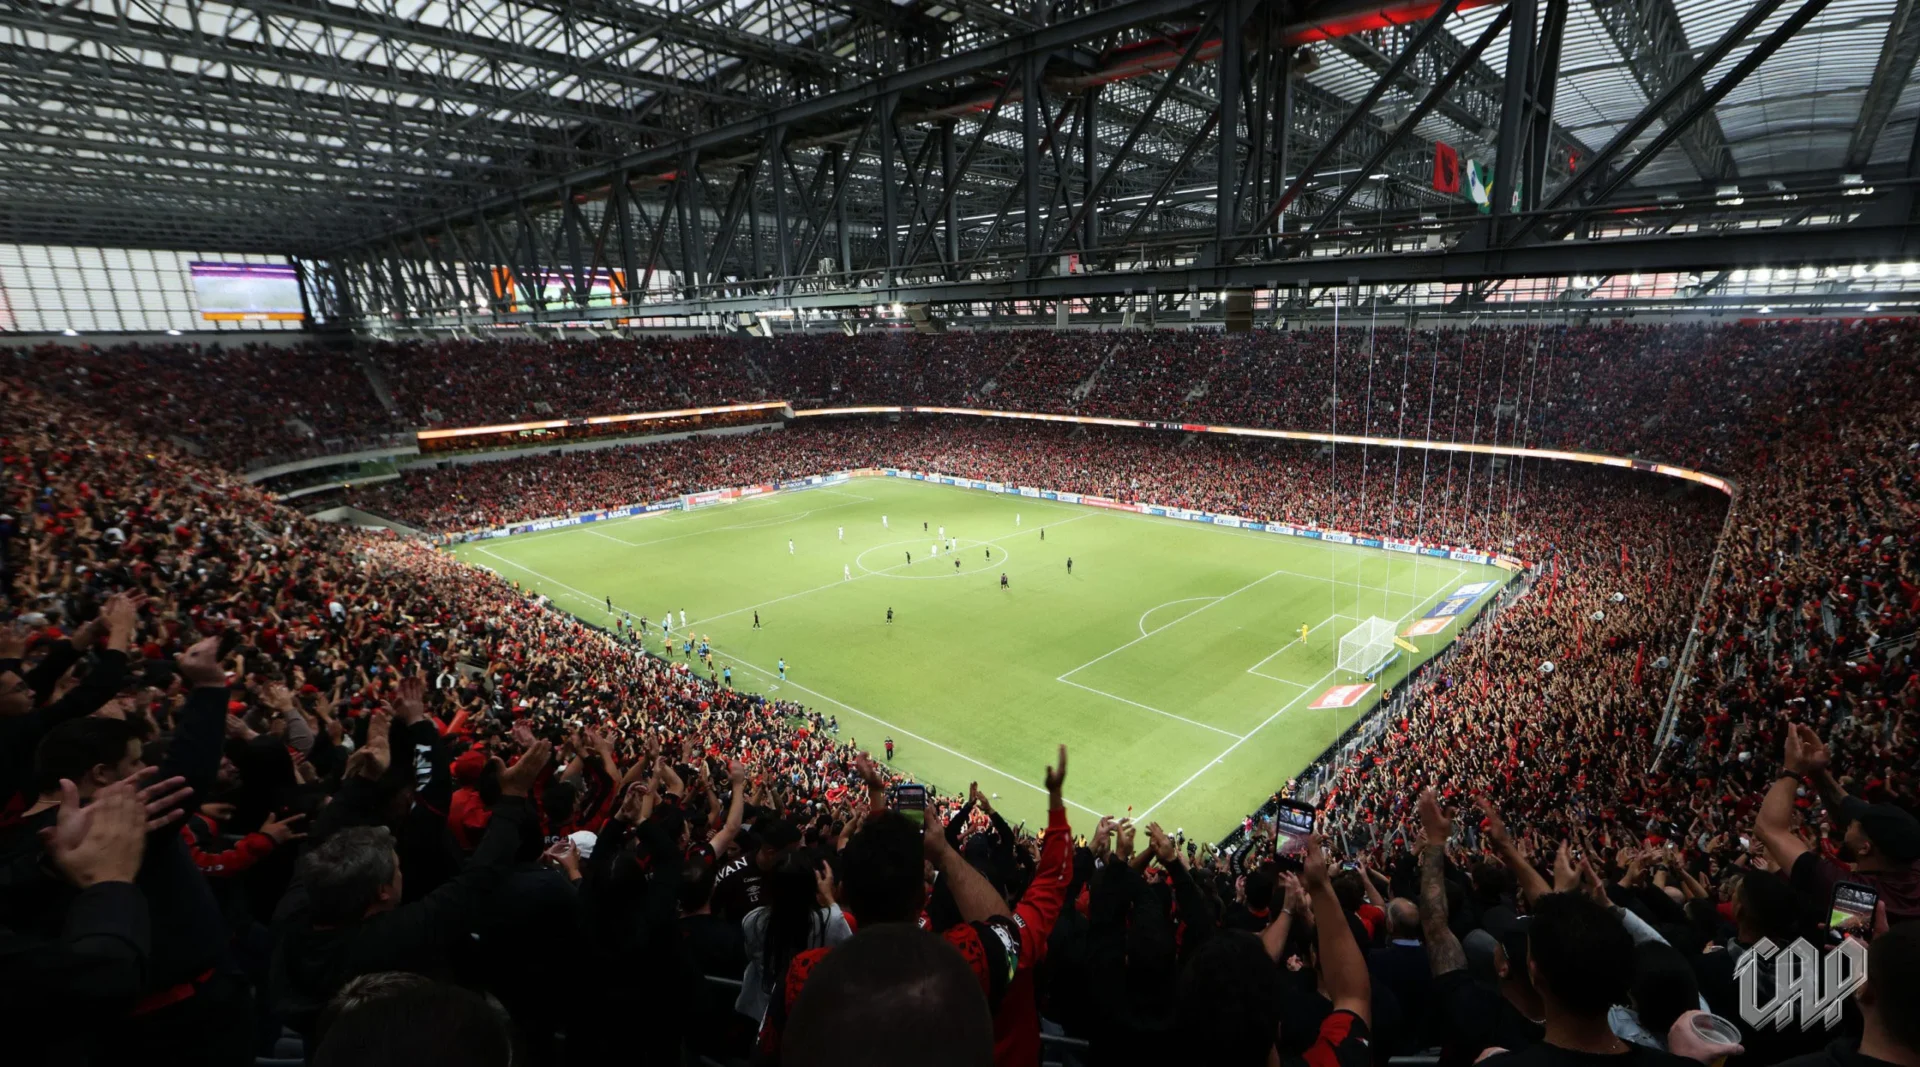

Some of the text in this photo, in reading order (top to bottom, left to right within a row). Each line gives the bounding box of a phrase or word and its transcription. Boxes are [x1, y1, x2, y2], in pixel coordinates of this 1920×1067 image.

[1326, 534, 1349, 542] 1XBET
[1387, 544, 1411, 552] 1XBET
[1420, 548, 1446, 556] 1XBET
[1455, 553, 1482, 561] 1XBET
